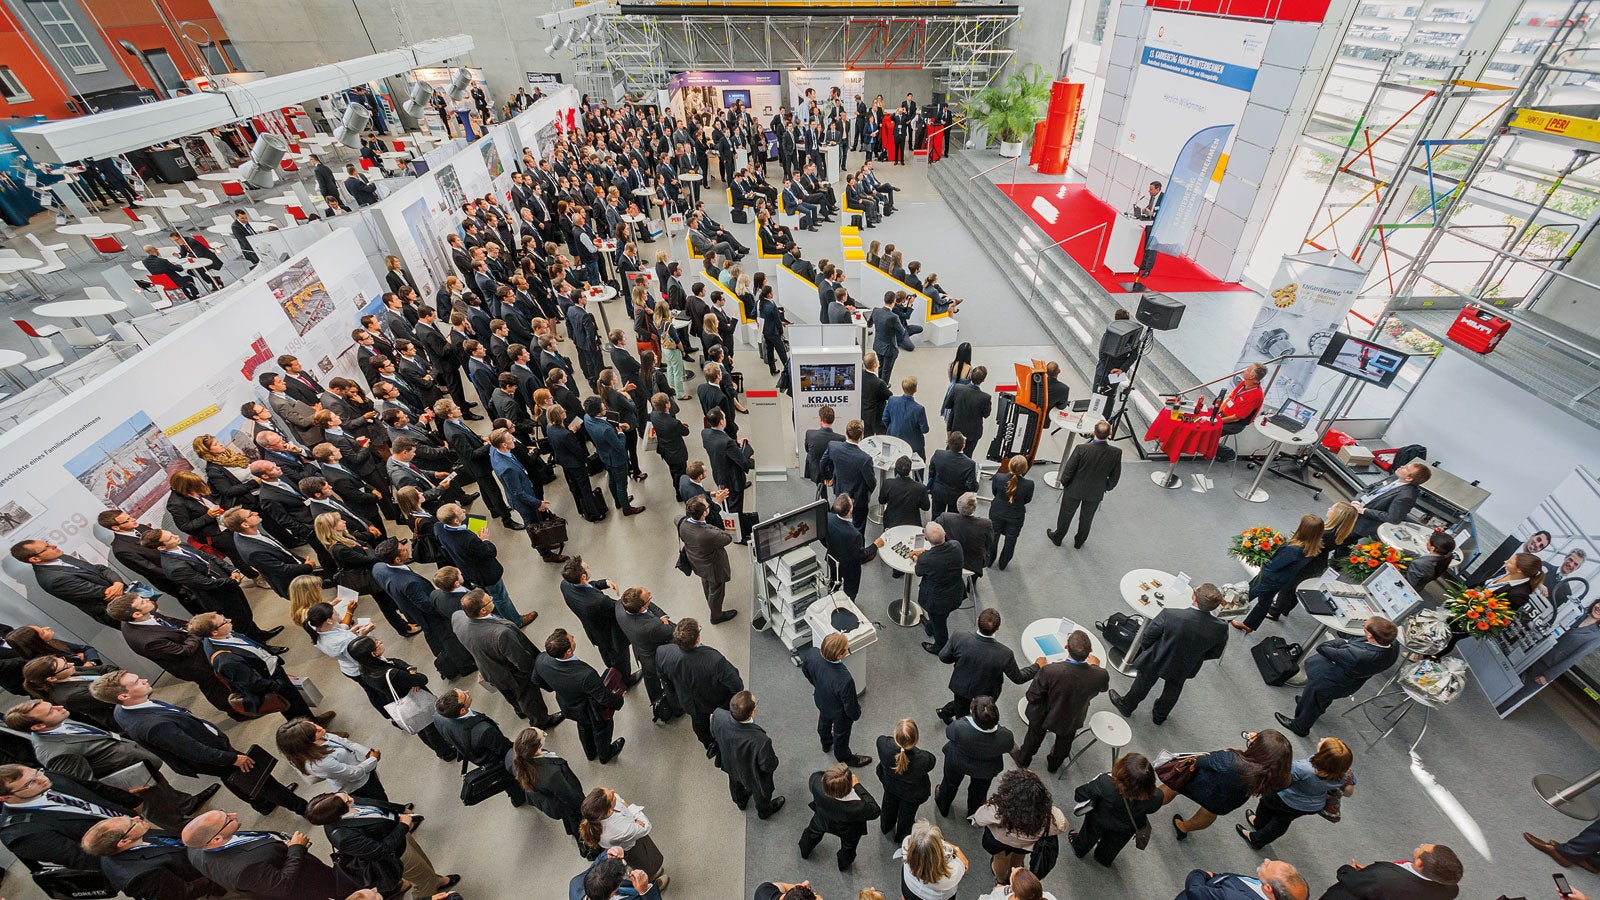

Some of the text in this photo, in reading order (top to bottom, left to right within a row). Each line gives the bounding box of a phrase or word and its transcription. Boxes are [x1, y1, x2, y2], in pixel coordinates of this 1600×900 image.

[1549, 118, 1571, 130] PERI
[1178, 138, 1220, 230] FAMILIENUNTERNEHMEN
[1302, 284, 1342, 296] ENGINEERING
[1460, 316, 1493, 335] HILTI
[808, 395, 848, 404] KRAUSE
[30, 454, 46, 466] eines
[44, 416, 102, 456] Familienunternehmens
[724, 519, 736, 528] RI
